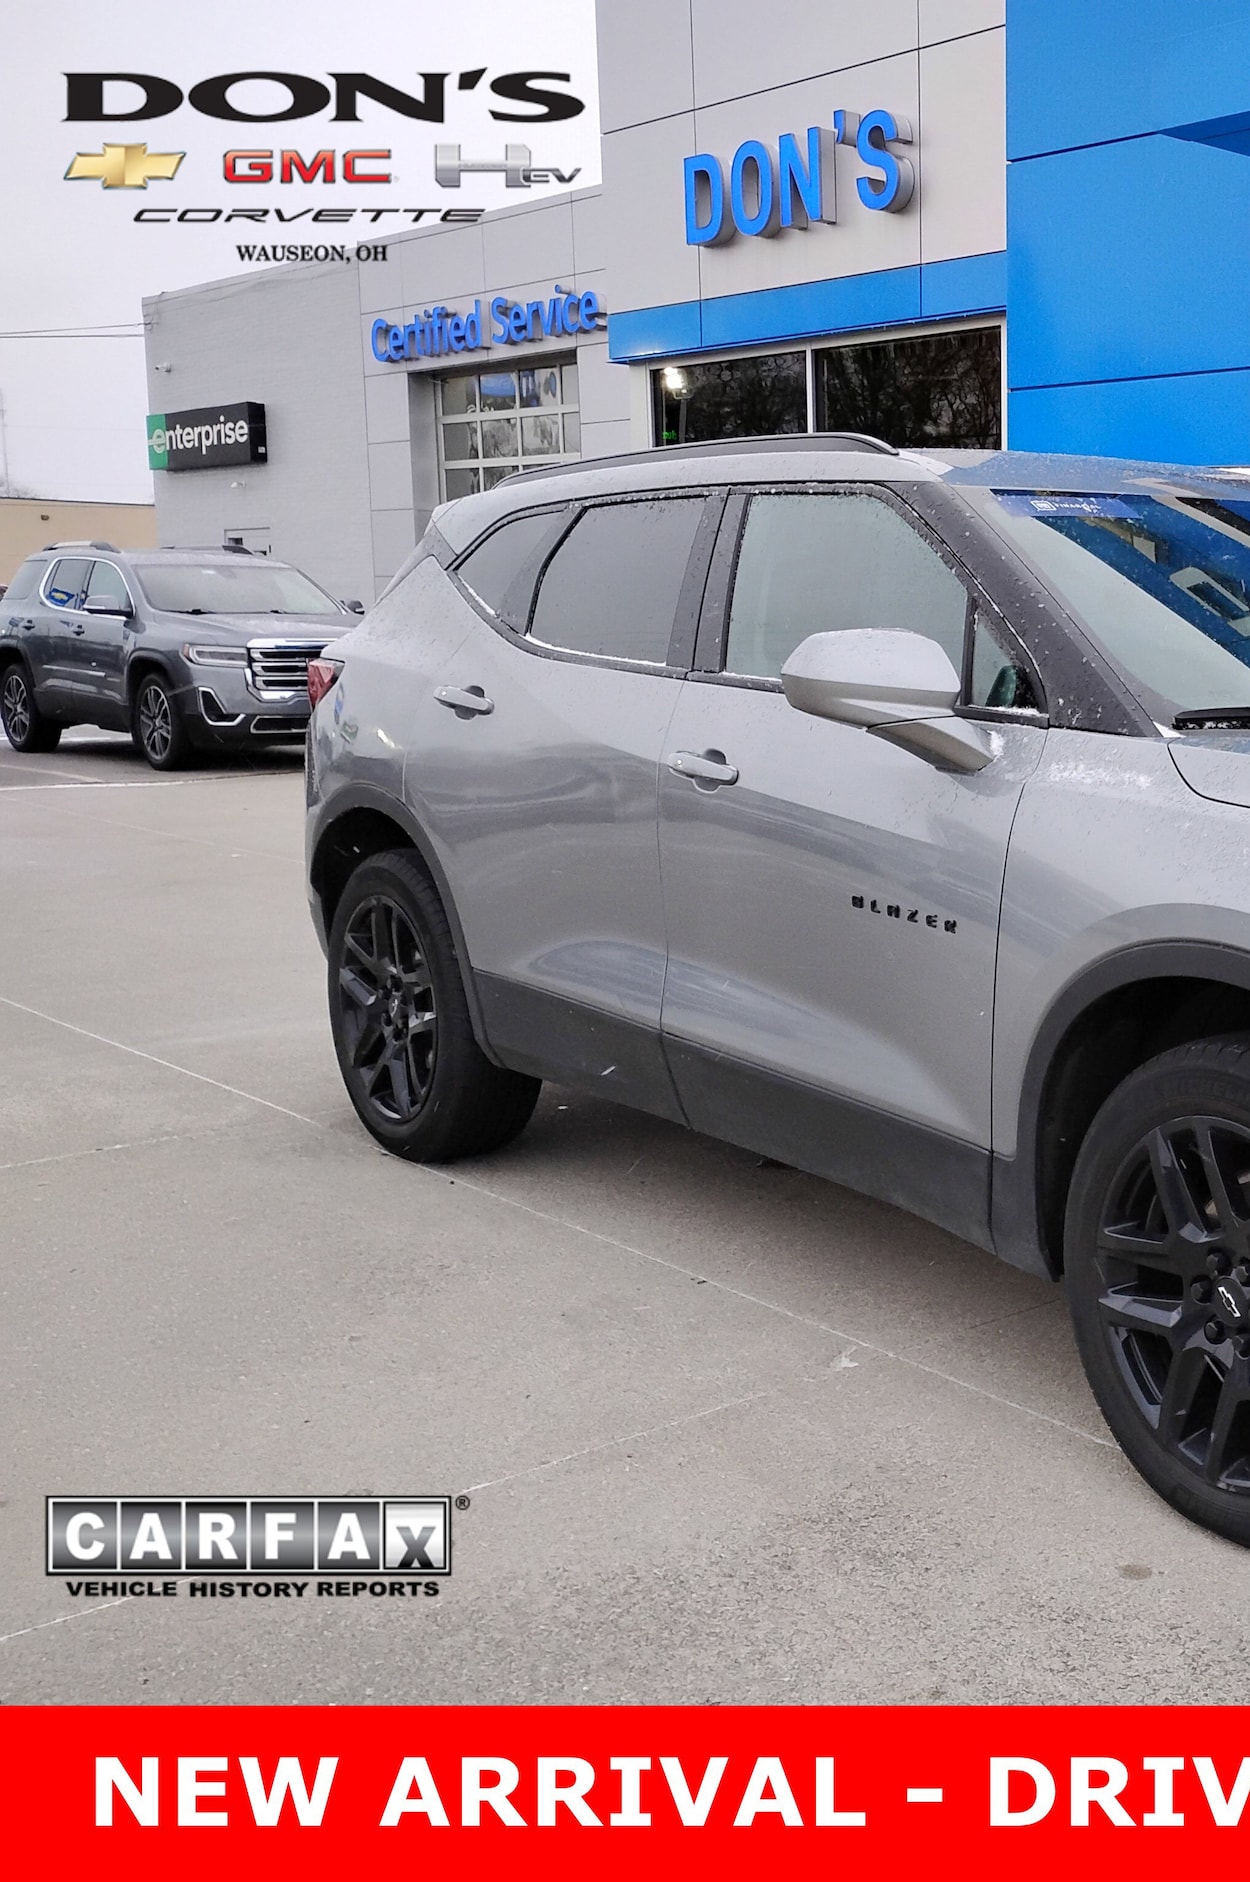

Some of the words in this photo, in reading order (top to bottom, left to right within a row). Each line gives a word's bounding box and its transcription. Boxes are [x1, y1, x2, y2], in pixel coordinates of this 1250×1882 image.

[684, 108, 909, 246] DON'S
[371, 299, 482, 362] Certified
[491, 284, 602, 344] Service
[148, 415, 249, 455] enterprise
[851, 895, 957, 934] BLAZER
